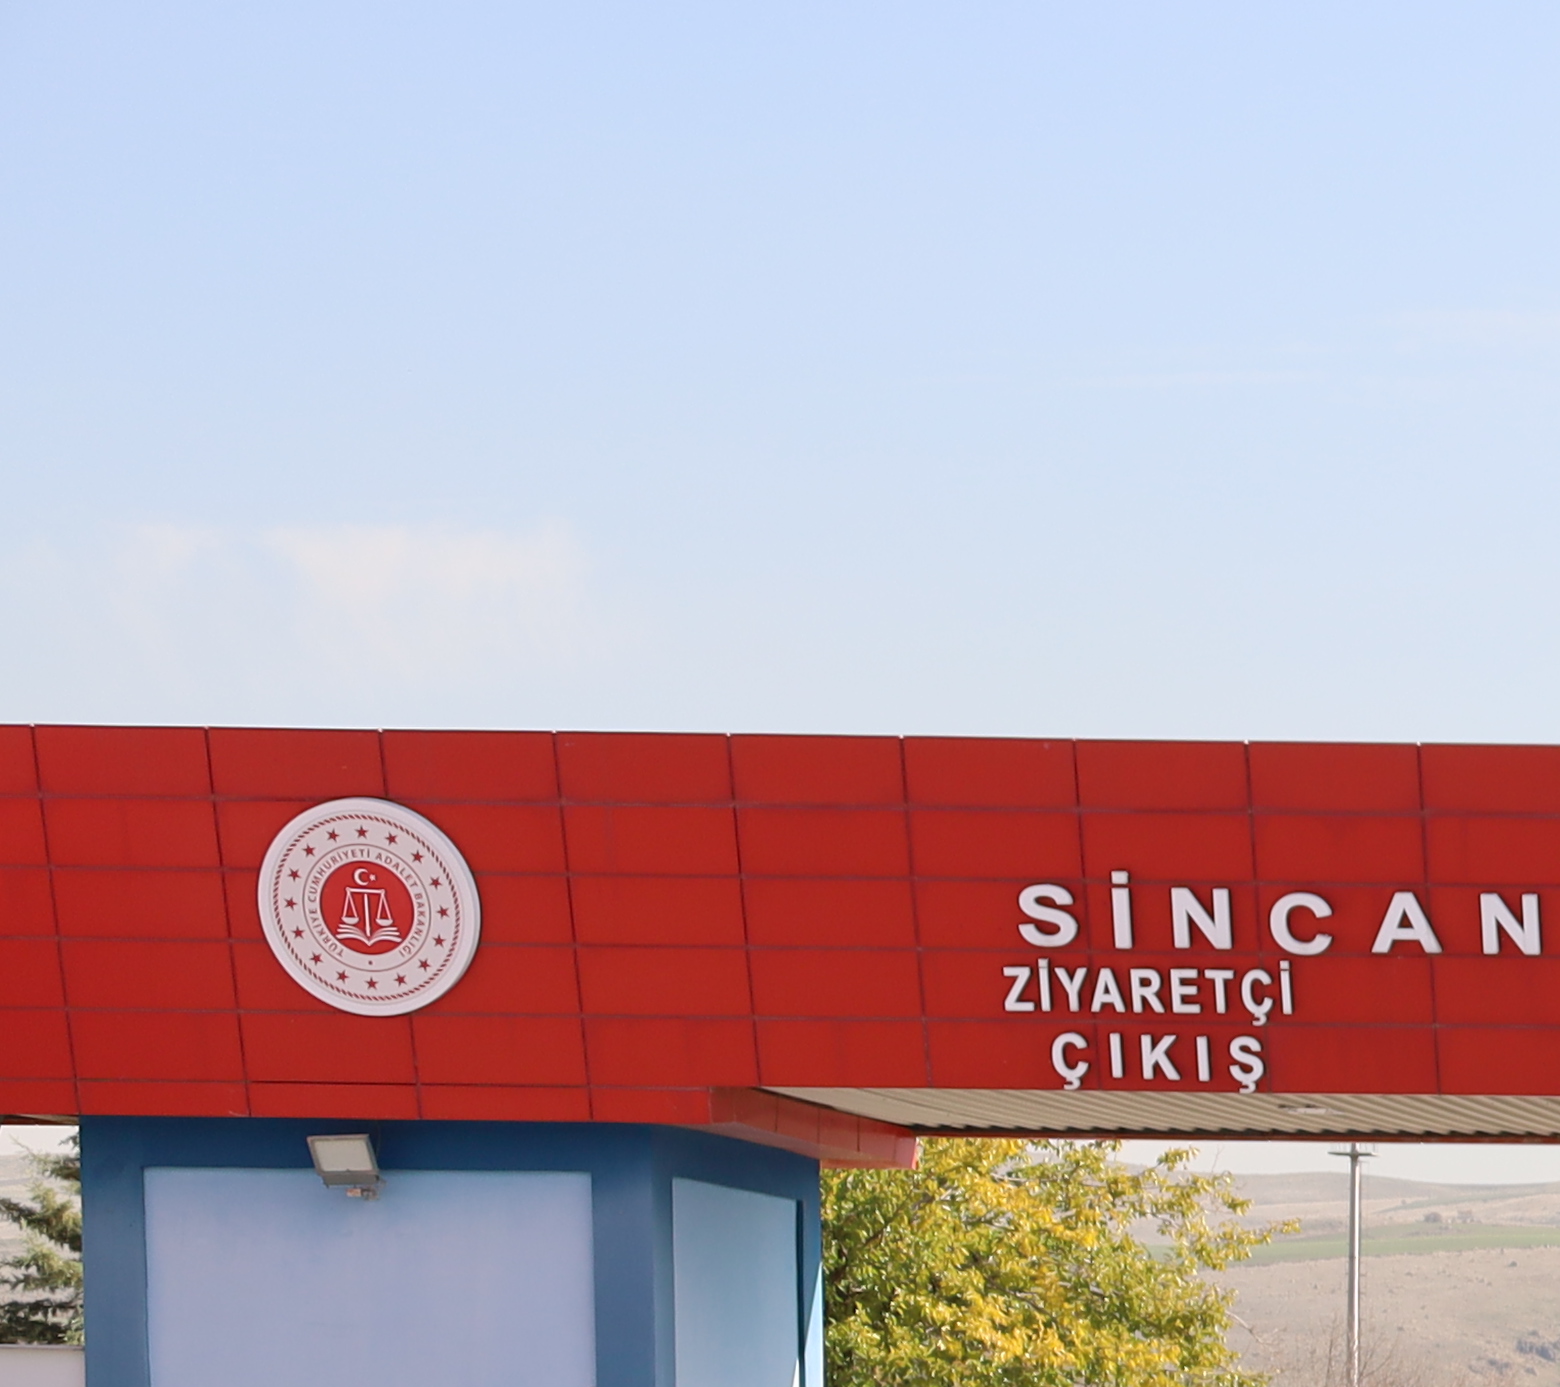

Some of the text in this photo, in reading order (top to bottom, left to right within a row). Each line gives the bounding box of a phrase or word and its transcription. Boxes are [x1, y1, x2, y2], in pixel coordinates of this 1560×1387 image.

[308, 848, 426, 958] TÜRKİYE CUMHURİYETİ ADALET BAKANLIĞI
[1018, 871, 1541, 956] SİNCAN
[1003, 958, 1292, 1026] ZİYARETÇİ
[1051, 1032, 1267, 1093] ÇIKIŞ
